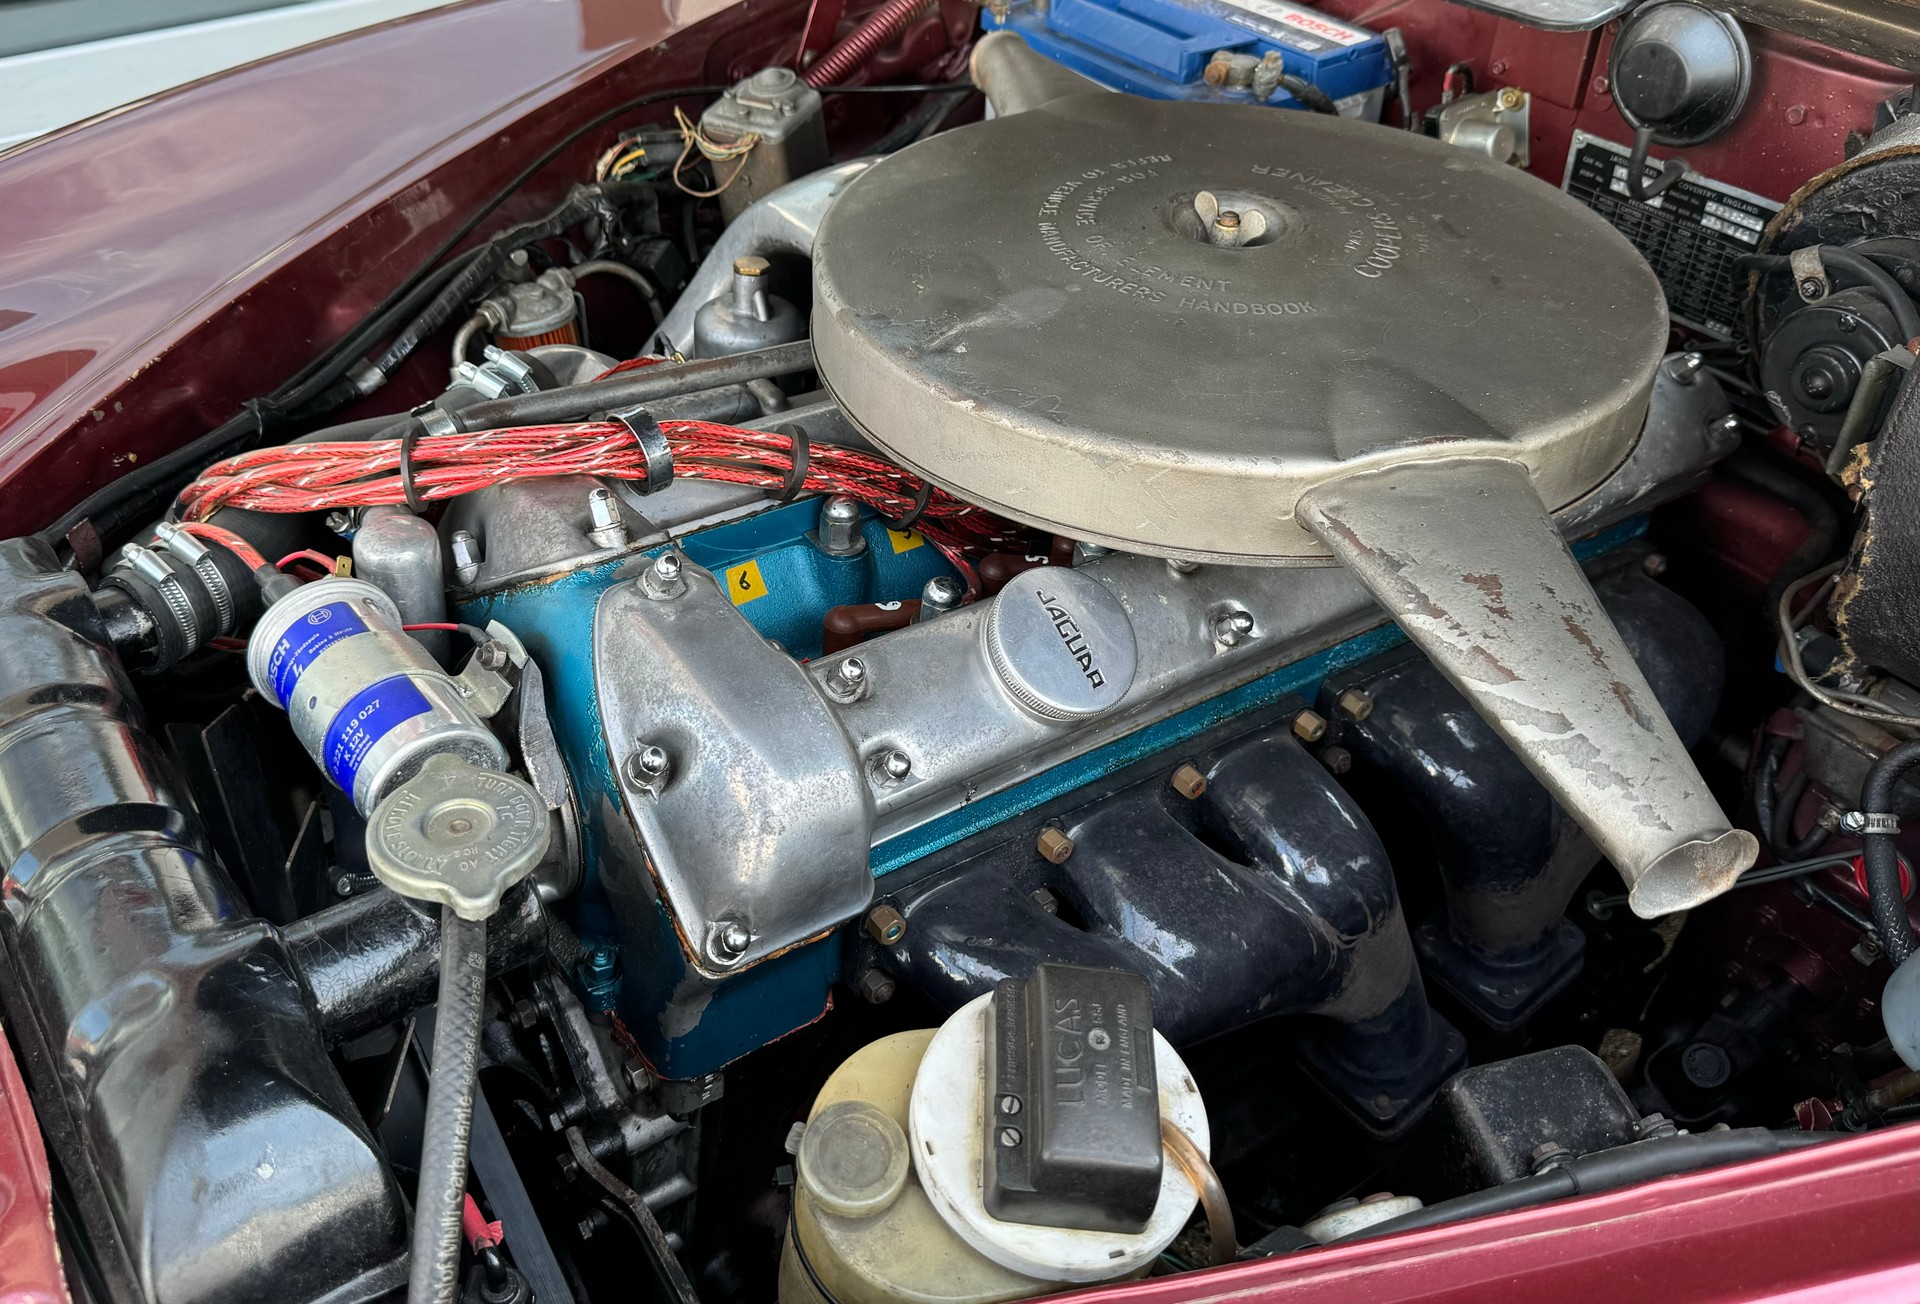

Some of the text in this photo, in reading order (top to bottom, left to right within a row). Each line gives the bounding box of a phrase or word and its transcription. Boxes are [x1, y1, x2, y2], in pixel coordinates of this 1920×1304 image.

[1284, 12, 1354, 40] BOSCH
[1038, 222, 1168, 303] MANUFACTURERS
[1179, 297, 1317, 316] HANDBOOK
[1353, 212, 1403, 278] COOPERS
[1115, 256, 1232, 292] ELEMENT
[739, 570, 751, 590] 6
[269, 638, 291, 689] OSCH
[1036, 589, 1107, 689] JAGUAR
[333, 743, 344, 767] 221
[341, 719, 359, 743] 119
[358, 699, 380, 720] 027
[343, 728, 364, 761] K 12V
[471, 976, 482, 1007] 12:58
[1053, 998, 1086, 1106] LUCAS
[1116, 1003, 1130, 1055] ENGLAND
[1120, 1058, 1132, 1071] IN
